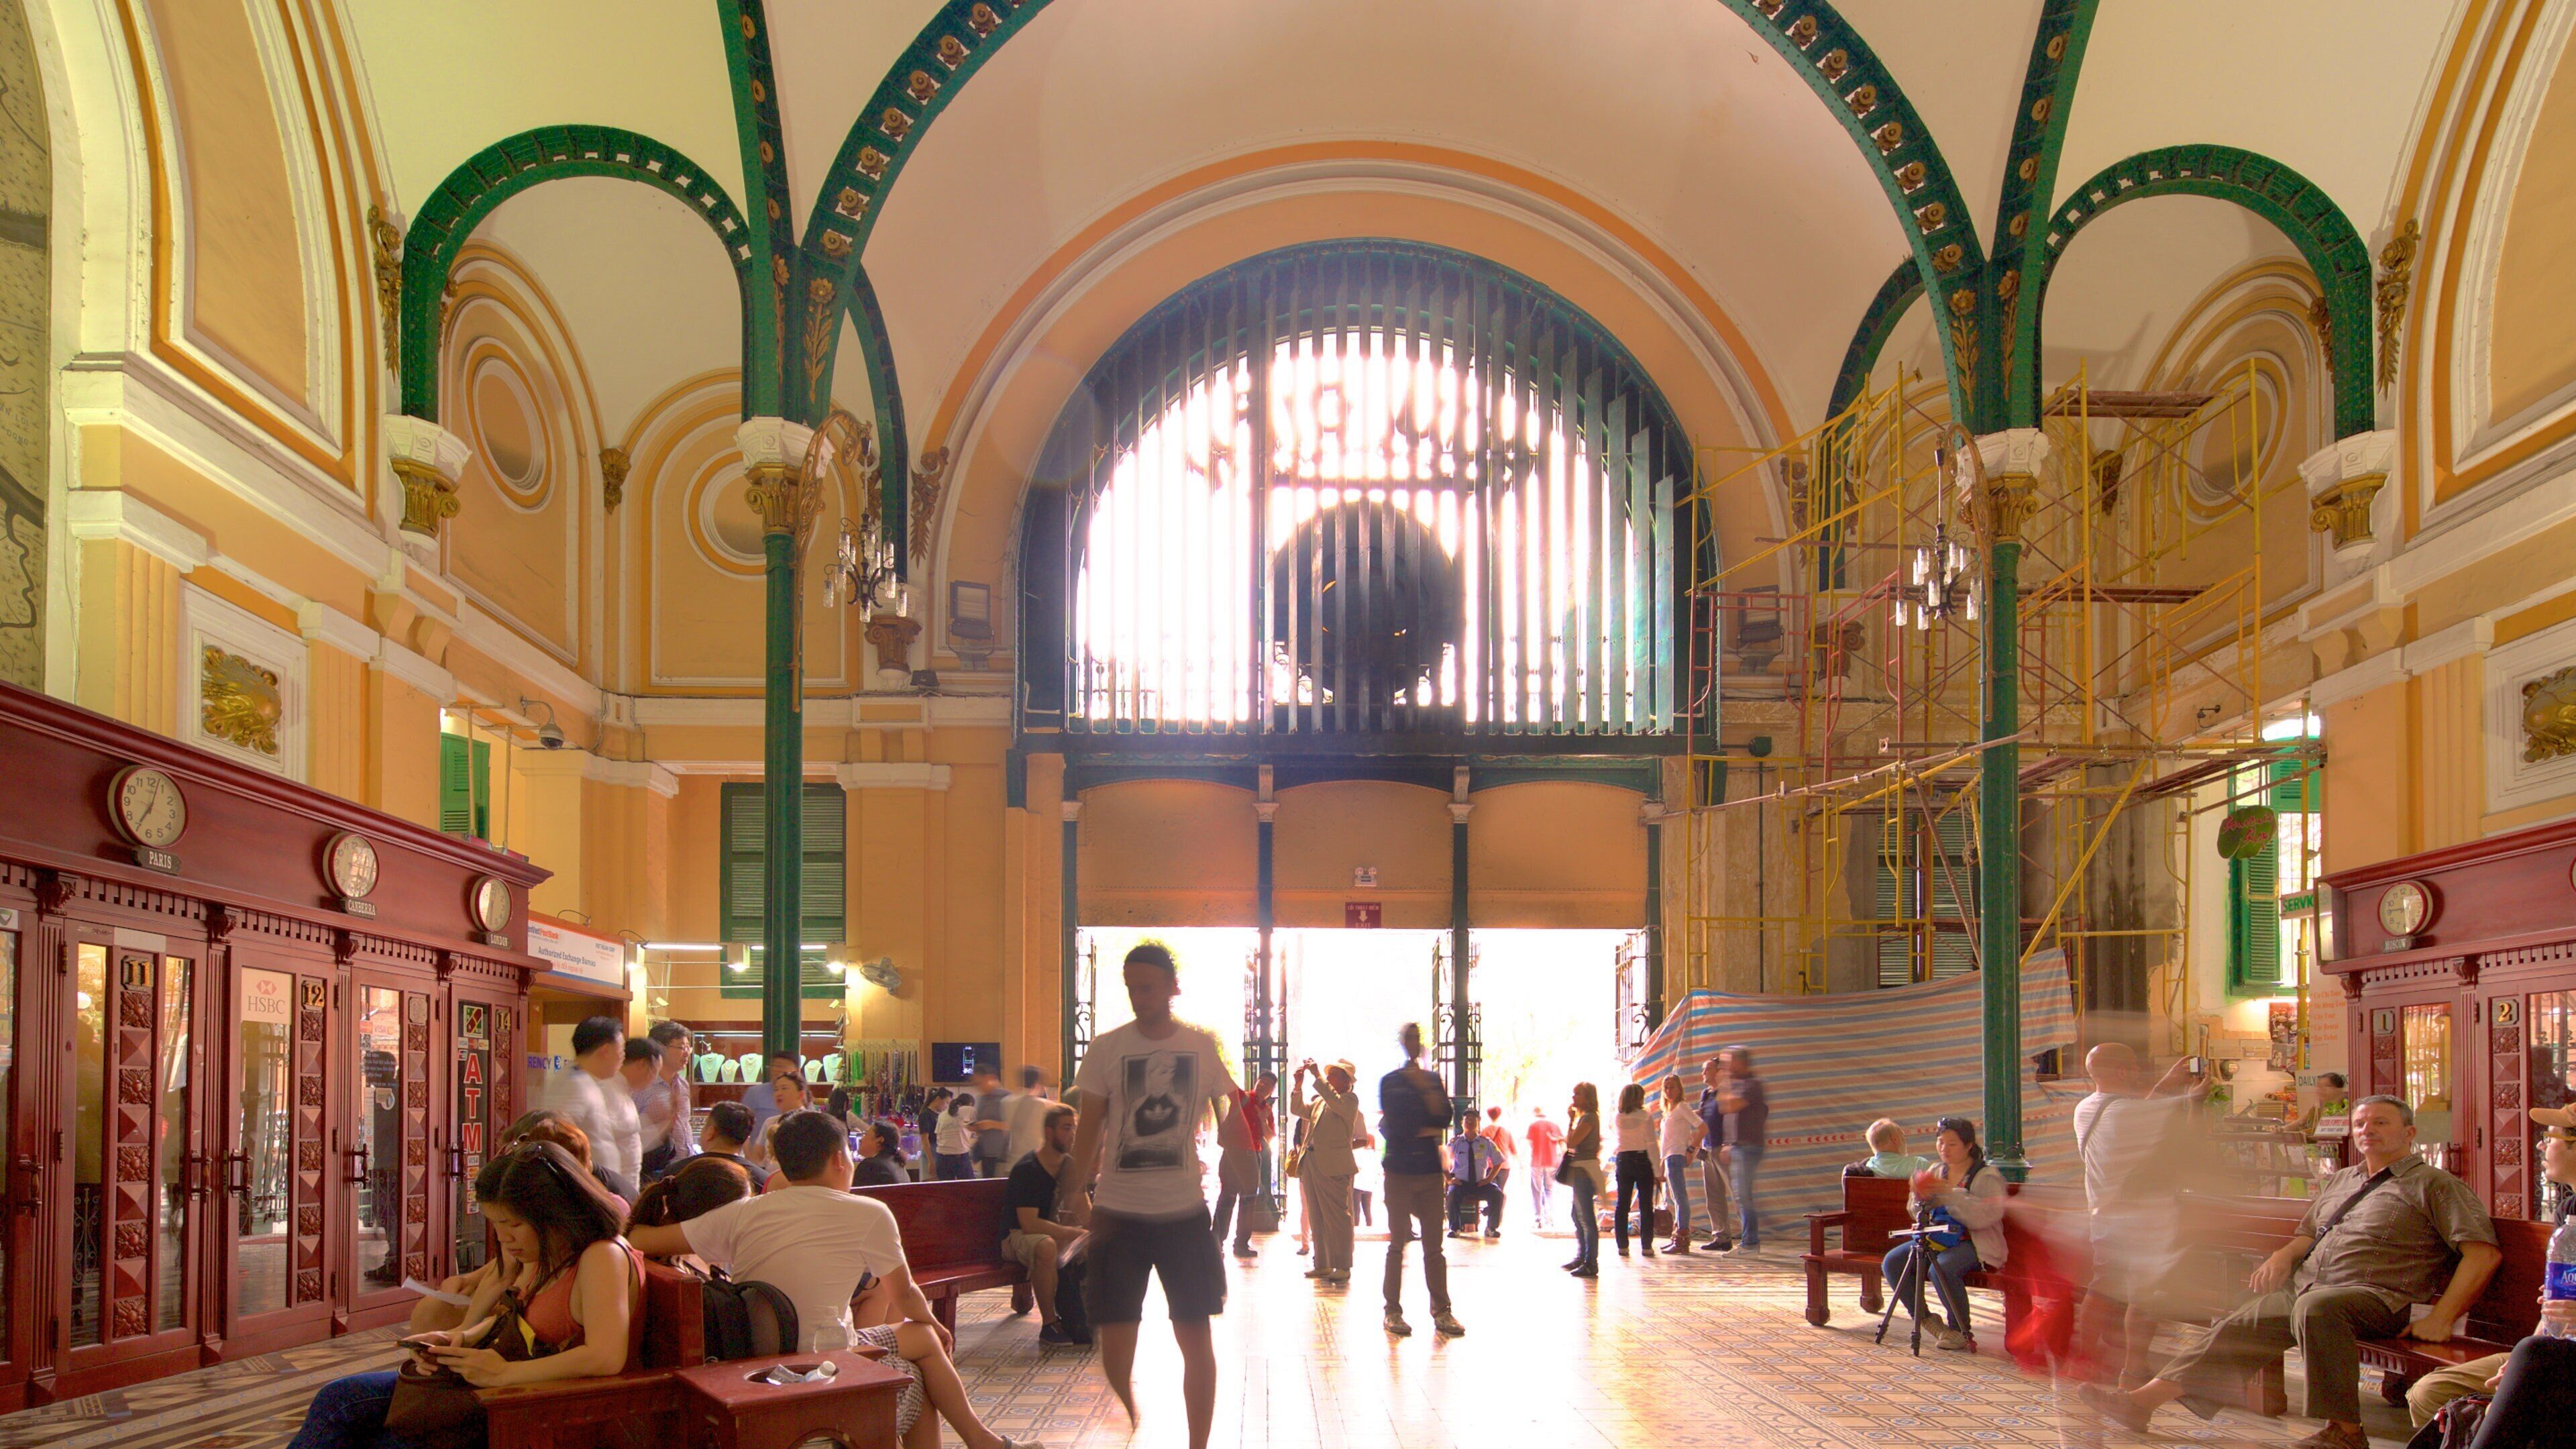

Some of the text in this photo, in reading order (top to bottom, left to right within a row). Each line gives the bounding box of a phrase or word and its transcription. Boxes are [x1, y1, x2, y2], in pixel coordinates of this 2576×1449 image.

[136, 777, 143, 787] 11
[147, 777, 156, 787] 12
[127, 785, 136, 795] 10
[160, 784, 164, 794] 1
[124, 796, 130, 806] 9
[167, 796, 173, 806] 2
[126, 810, 133, 820] 8
[169, 810, 176, 819] 3
[136, 822, 142, 832] 7
[166, 822, 172, 830] 4
[146, 828, 152, 839] 6
[157, 828, 163, 838] 5
[149, 851, 172, 869] PARIS
[348, 900, 376, 916] CANBERRA
[490, 934, 508, 947] LONDON
[2385, 938, 2407, 950] MOSCOW
[538, 946, 561, 959] Authorized
[562, 952, 582, 965] Exchange
[582, 957, 596, 967] Bureau
[127, 960, 151, 986] 11
[305, 983, 325, 1007] 12
[247, 996, 285, 1014] HSBC
[2498, 1003, 2512, 1022] 2
[500, 1012, 511, 1031] 14
[2380, 1014, 2388, 1031] 1
[374, 1024, 386, 1033] VISA
[528, 1056, 551, 1069] RENCY
[2298, 1075, 2316, 1087] DAILY
[462, 1053, 483, 1154] ATM
[469, 1157, 478, 1165] VISA
